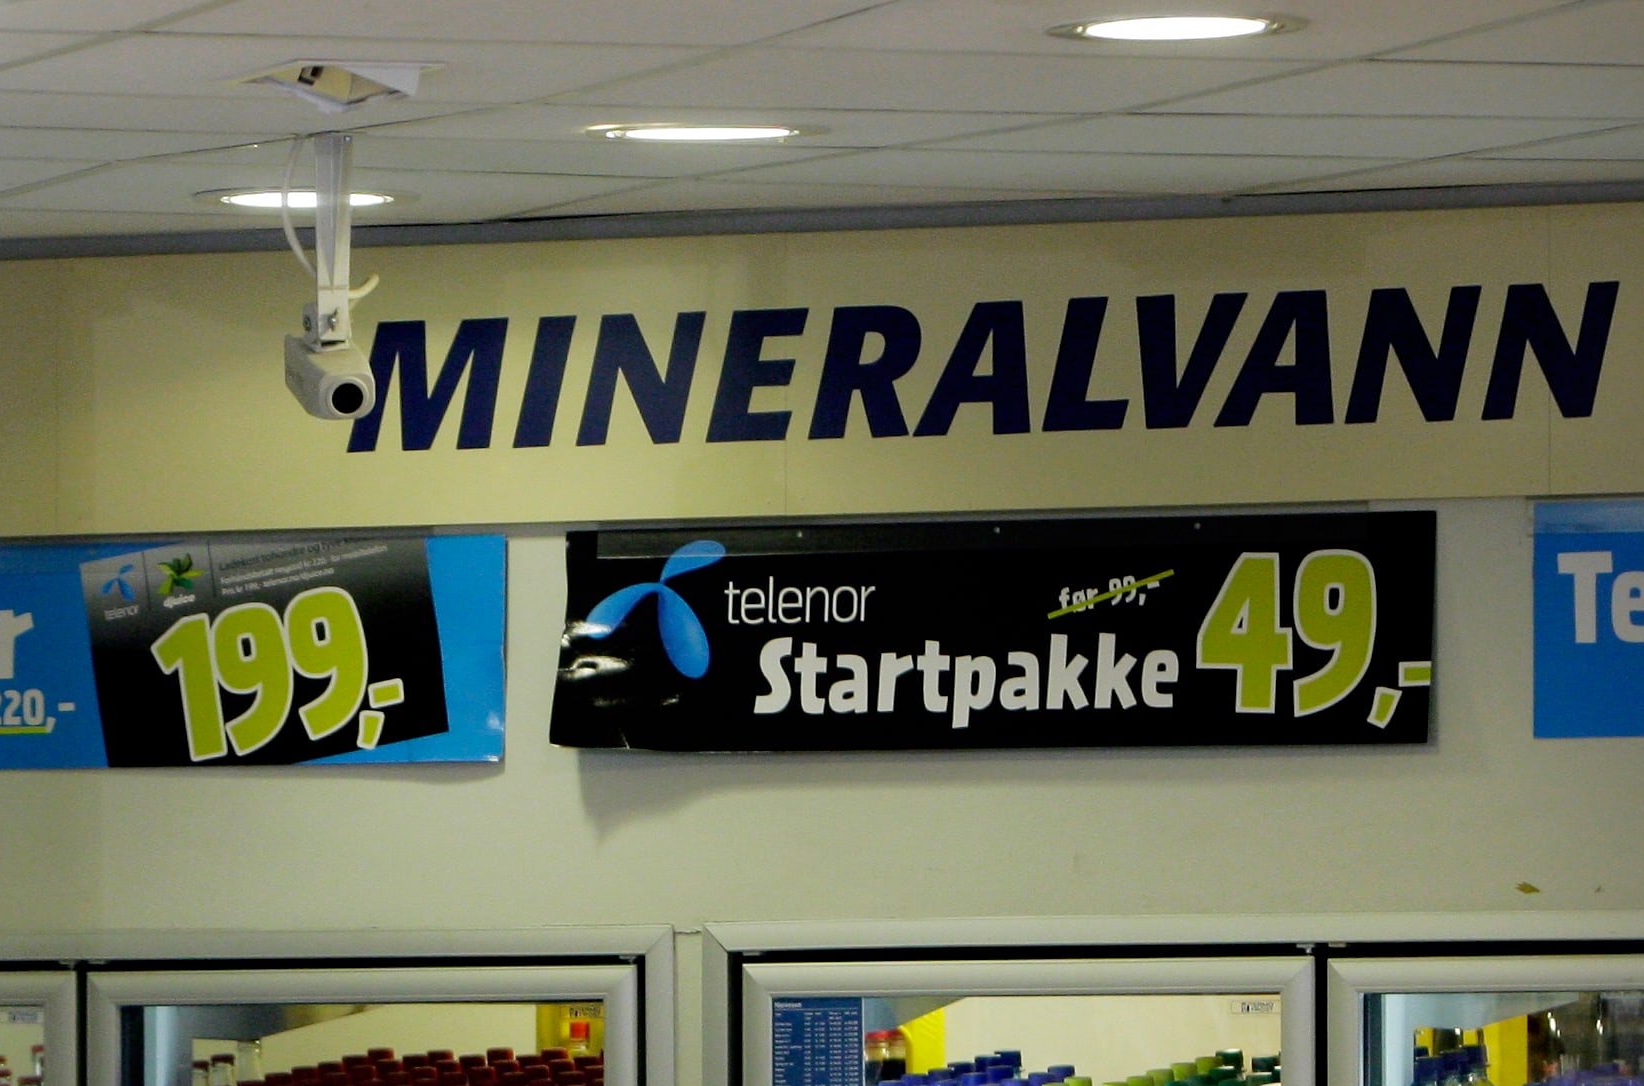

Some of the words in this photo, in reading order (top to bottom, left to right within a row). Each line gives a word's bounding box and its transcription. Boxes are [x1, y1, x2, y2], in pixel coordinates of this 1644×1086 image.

[347, 280, 1620, 453] MINERALVANN
[104, 604, 138, 620] telenor
[725, 576, 875, 625] telenor
[754, 632, 1179, 728] Startpakke
[1196, 548, 1431, 728] 49,-
[1059, 587, 1098, 613] før
[1557, 550, 1644, 645] Te
[150, 586, 404, 762] 199,-
